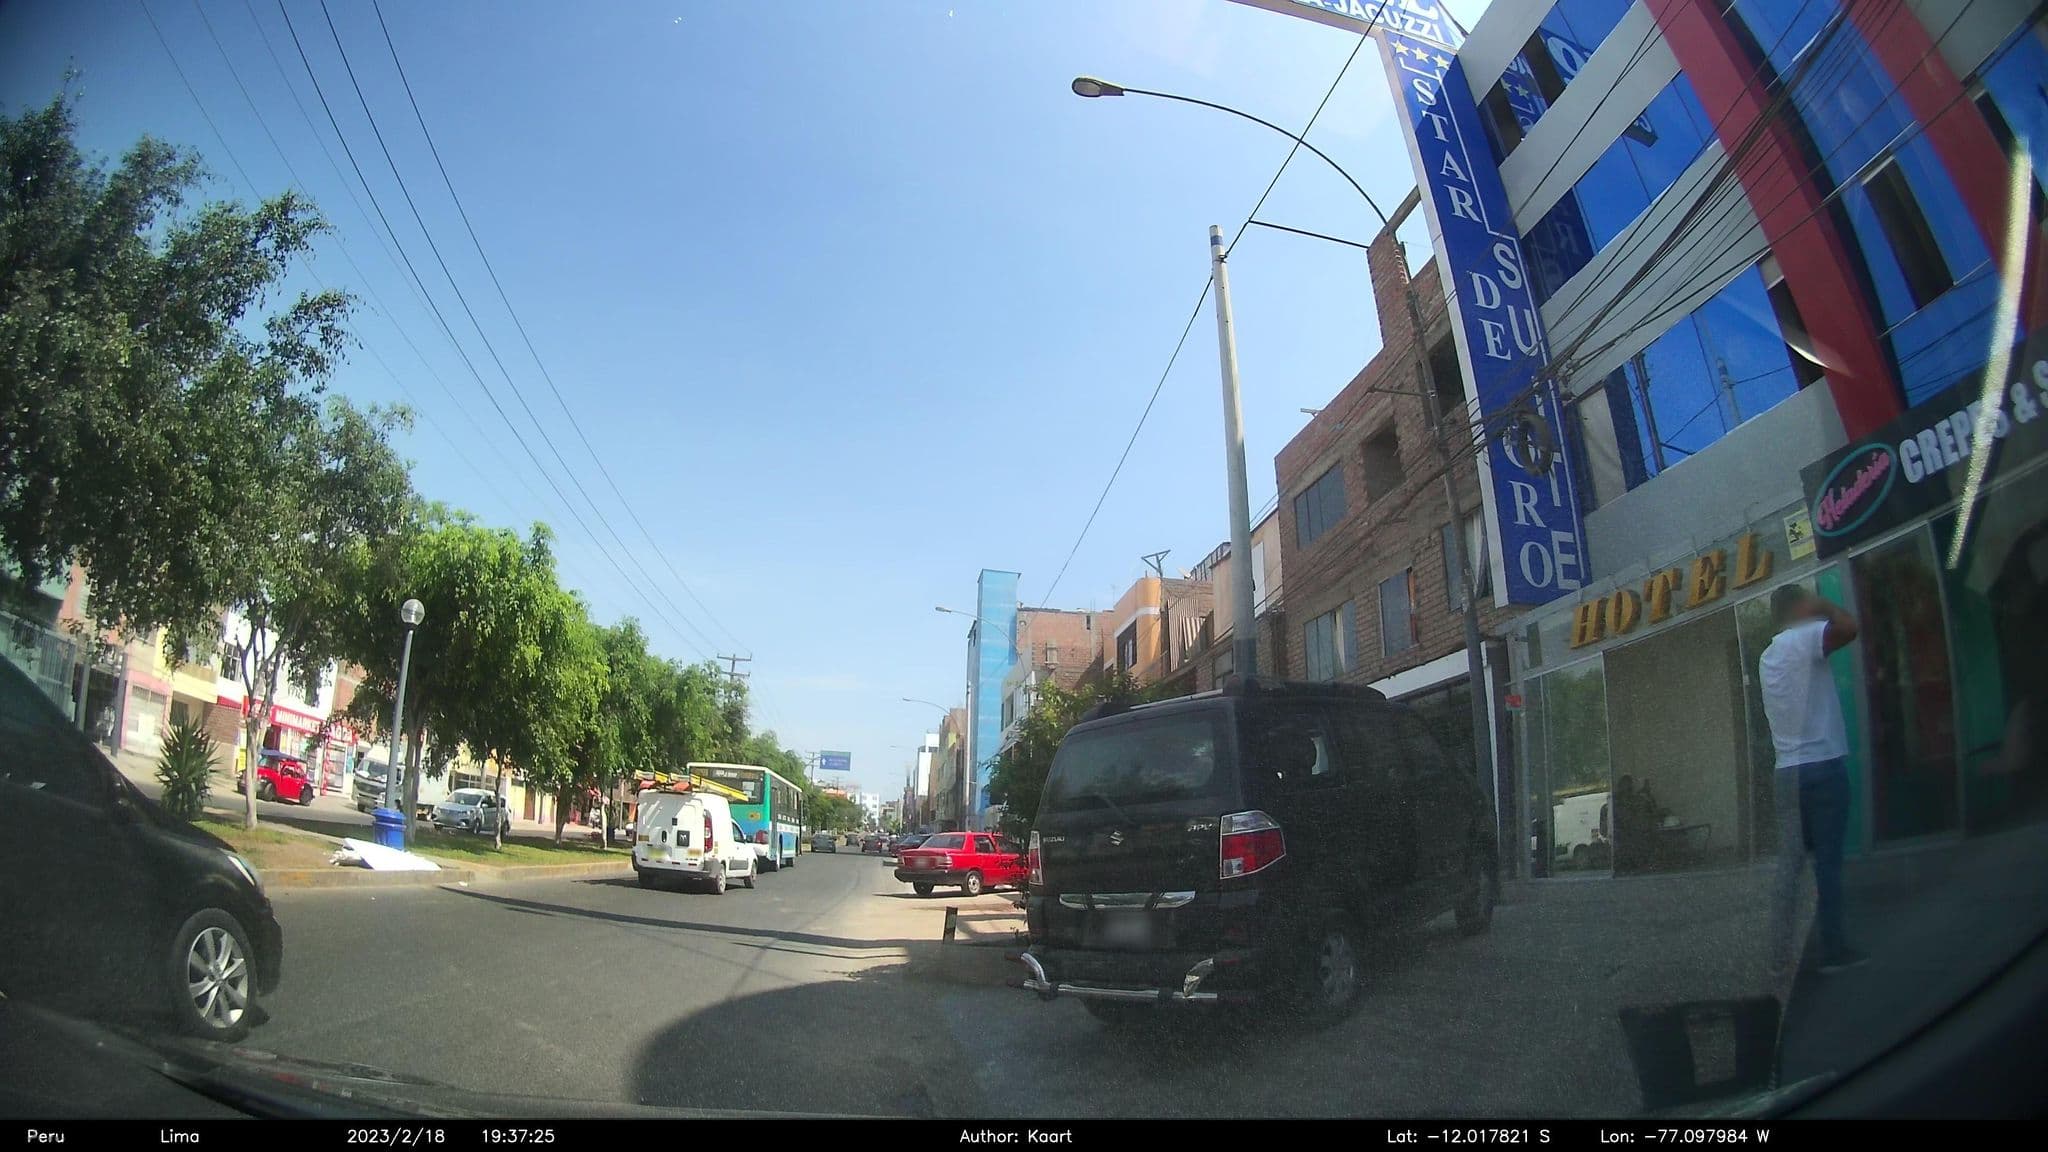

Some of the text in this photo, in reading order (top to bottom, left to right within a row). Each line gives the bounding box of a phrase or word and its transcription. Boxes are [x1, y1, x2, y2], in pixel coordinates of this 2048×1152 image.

[1412, 77, 1483, 223] STAR
[1467, 270, 1512, 361] DE
[2010, 381, 2038, 424] &
[1570, 530, 1775, 650] HOTEL
